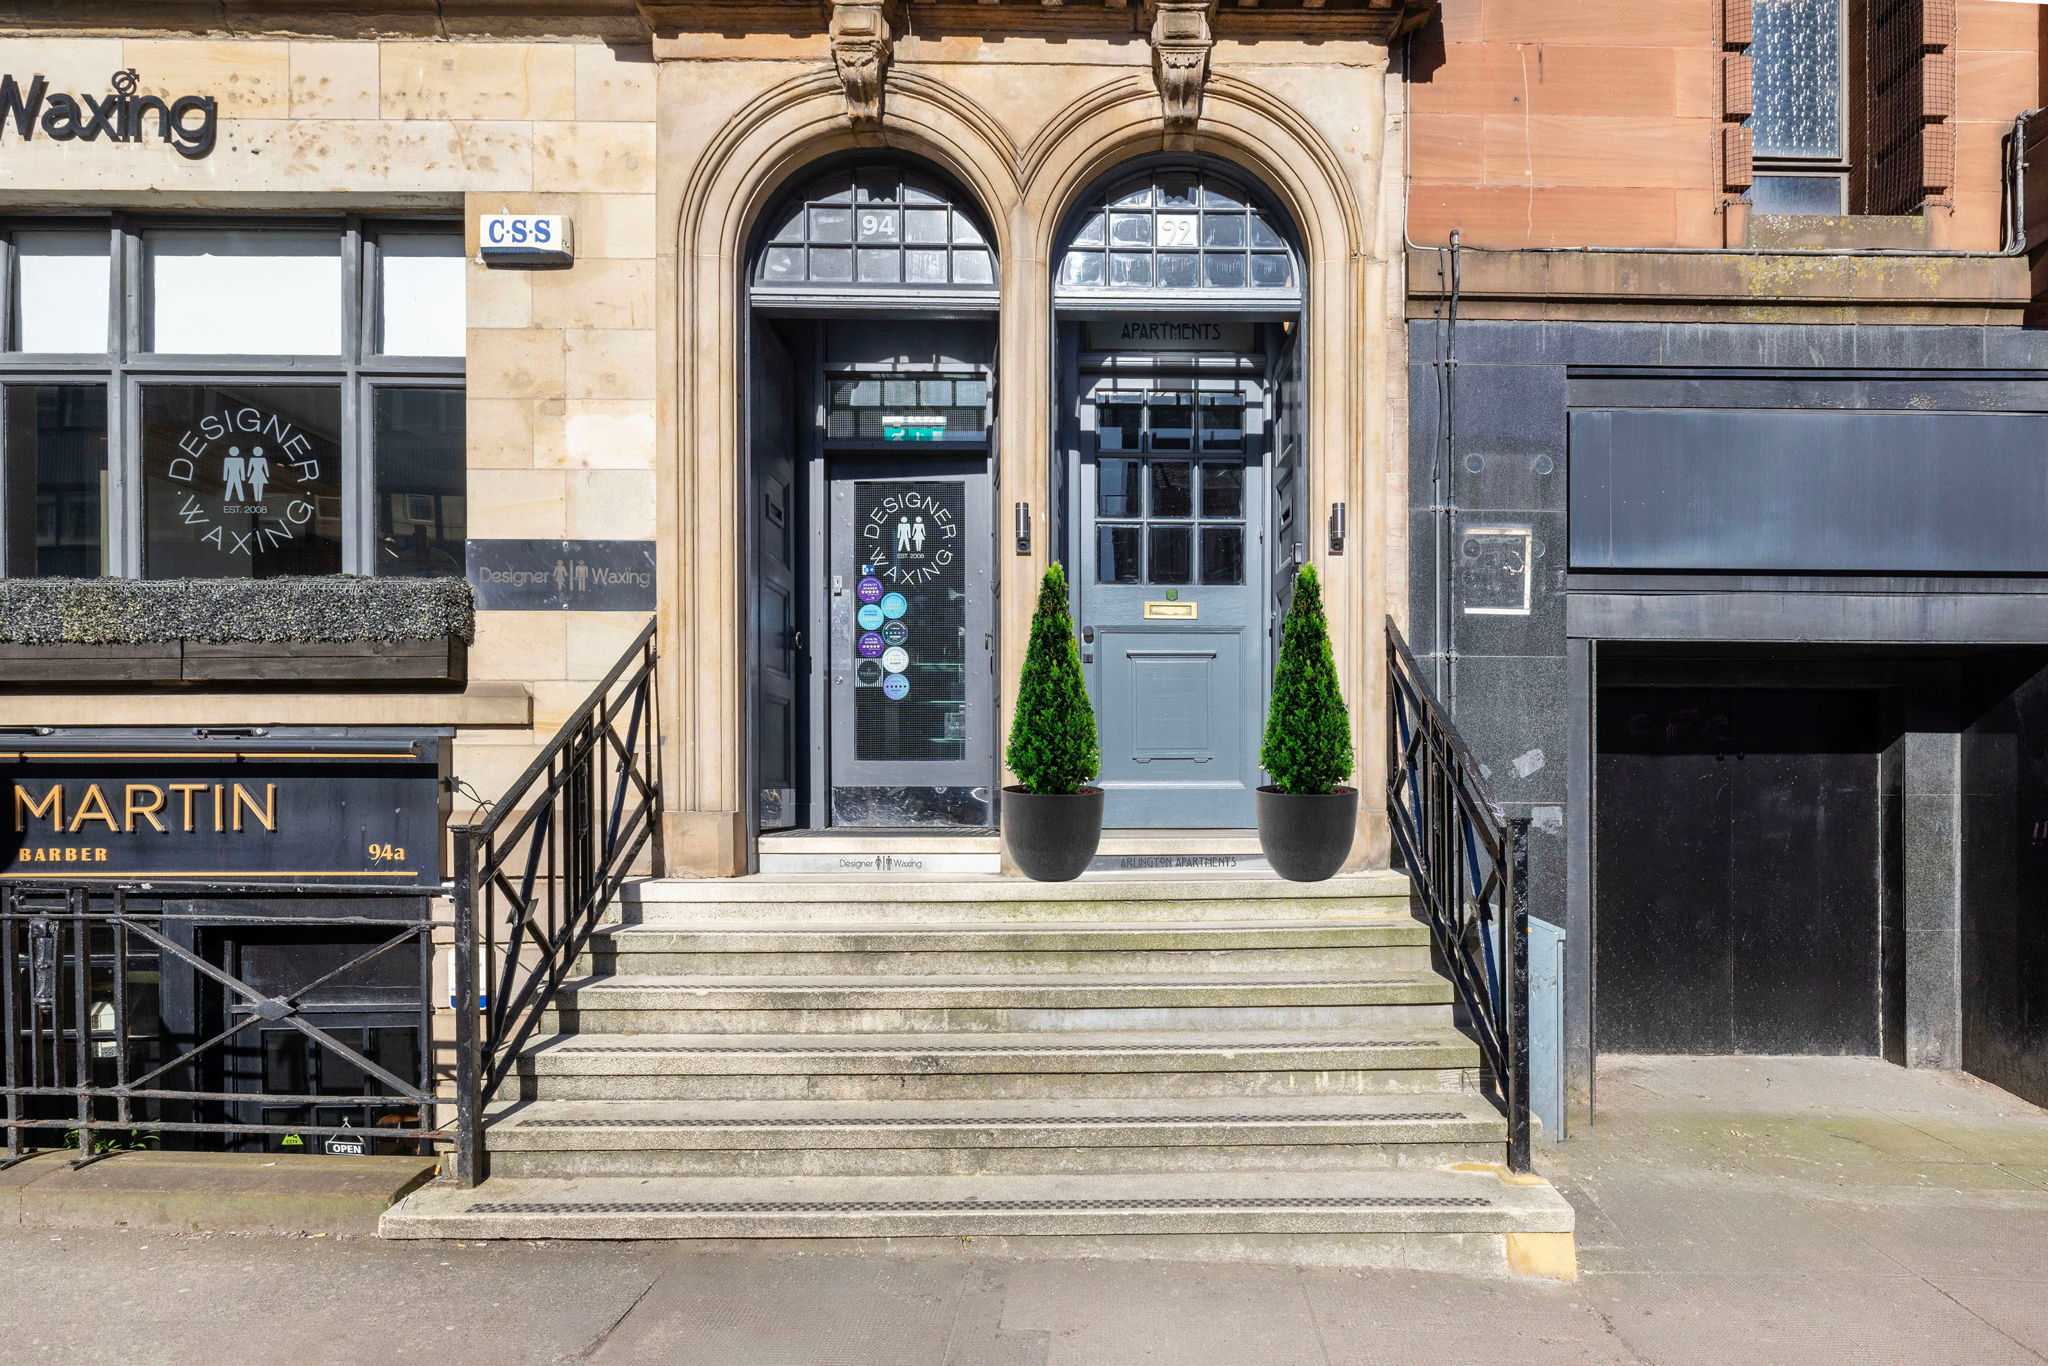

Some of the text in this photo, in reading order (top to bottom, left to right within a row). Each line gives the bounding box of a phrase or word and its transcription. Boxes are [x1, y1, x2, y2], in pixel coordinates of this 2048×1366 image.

[0, 70, 217, 160] Waxing
[862, 215, 896, 235] 94
[1121, 321, 1222, 341] APARTMENTS
[168, 408, 320, 482] DESIGNER
[179, 494, 315, 556] WAXING
[863, 492, 957, 540] DESIGNER
[870, 546, 954, 585] WAXING
[479, 566, 651, 588] Designer Waxing
[14, 783, 277, 833] MARTIN
[19, 847, 109, 862] BARBER
[368, 844, 406, 865] 94a
[839, 859, 922, 869] Designer Waxing
[1120, 857, 1237, 869] ARLINGTON APARTMENTS
[332, 1143, 362, 1154] OPEN
